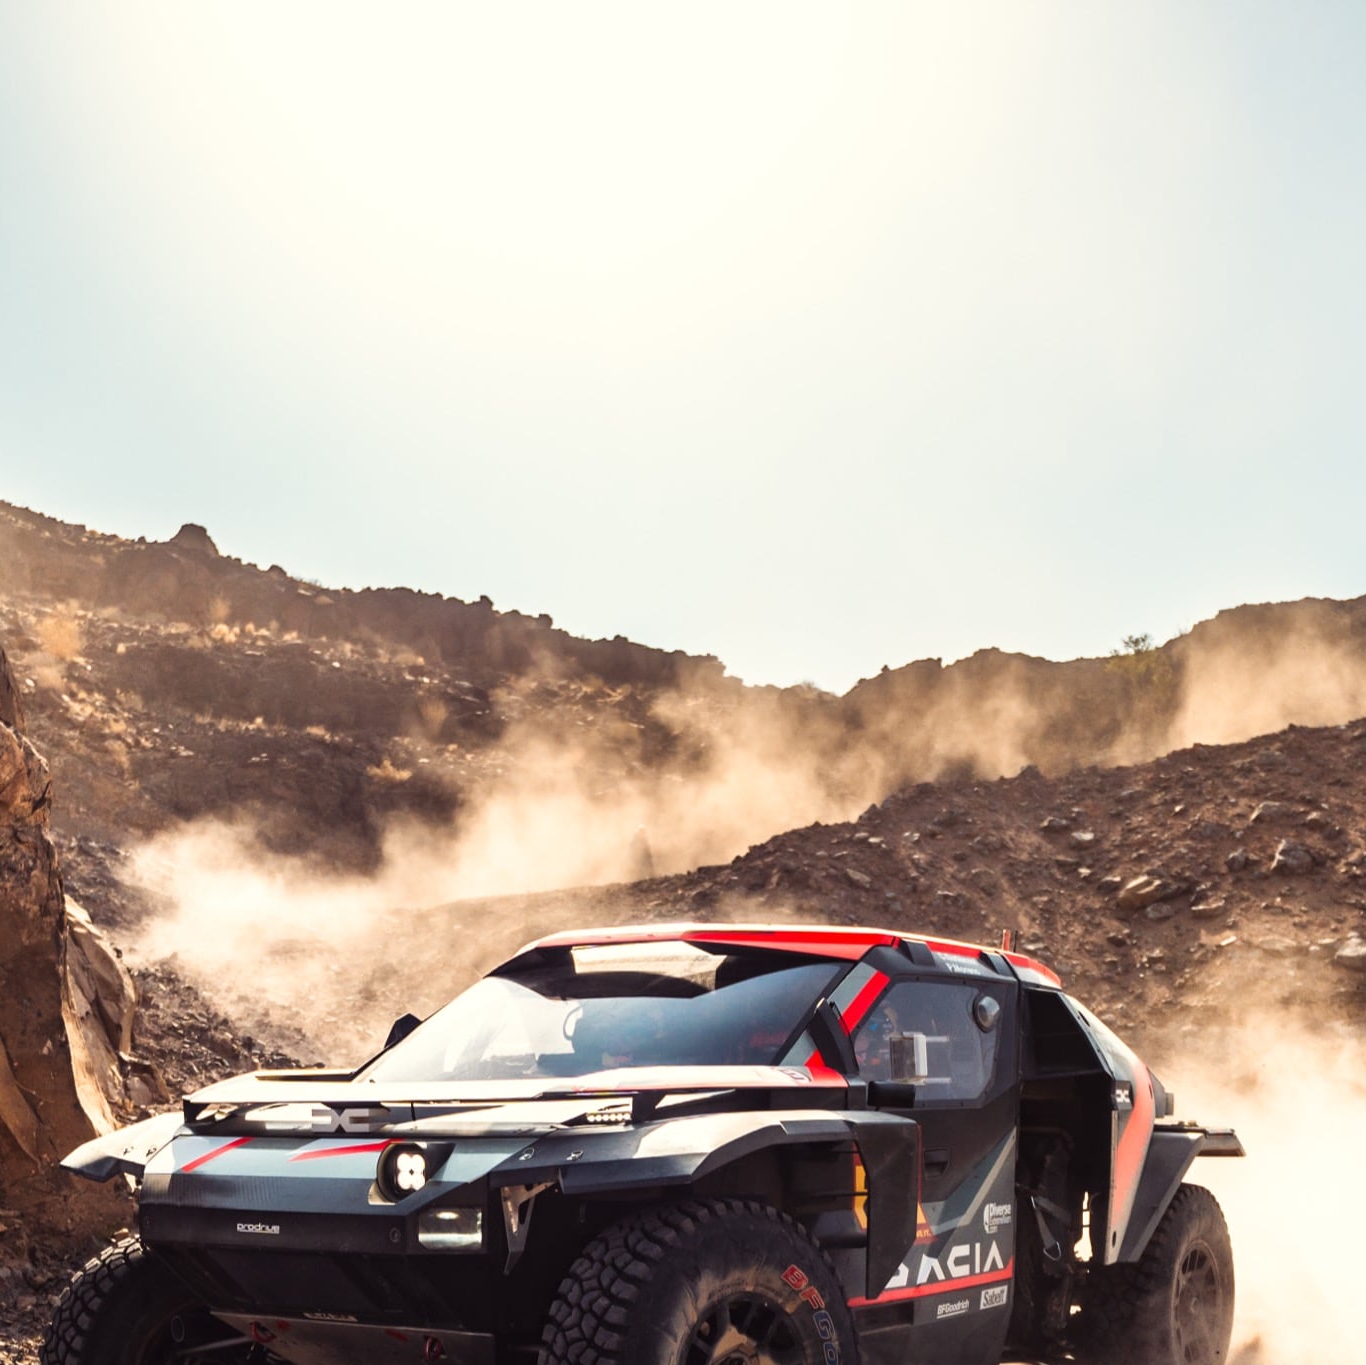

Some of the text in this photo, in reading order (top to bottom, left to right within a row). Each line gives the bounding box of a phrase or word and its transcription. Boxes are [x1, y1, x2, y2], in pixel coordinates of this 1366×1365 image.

[237, 1222, 280, 1234] prodrive
[983, 1288, 1005, 1307] Sabelt
[937, 1299, 970, 1315] BFGoodrich
